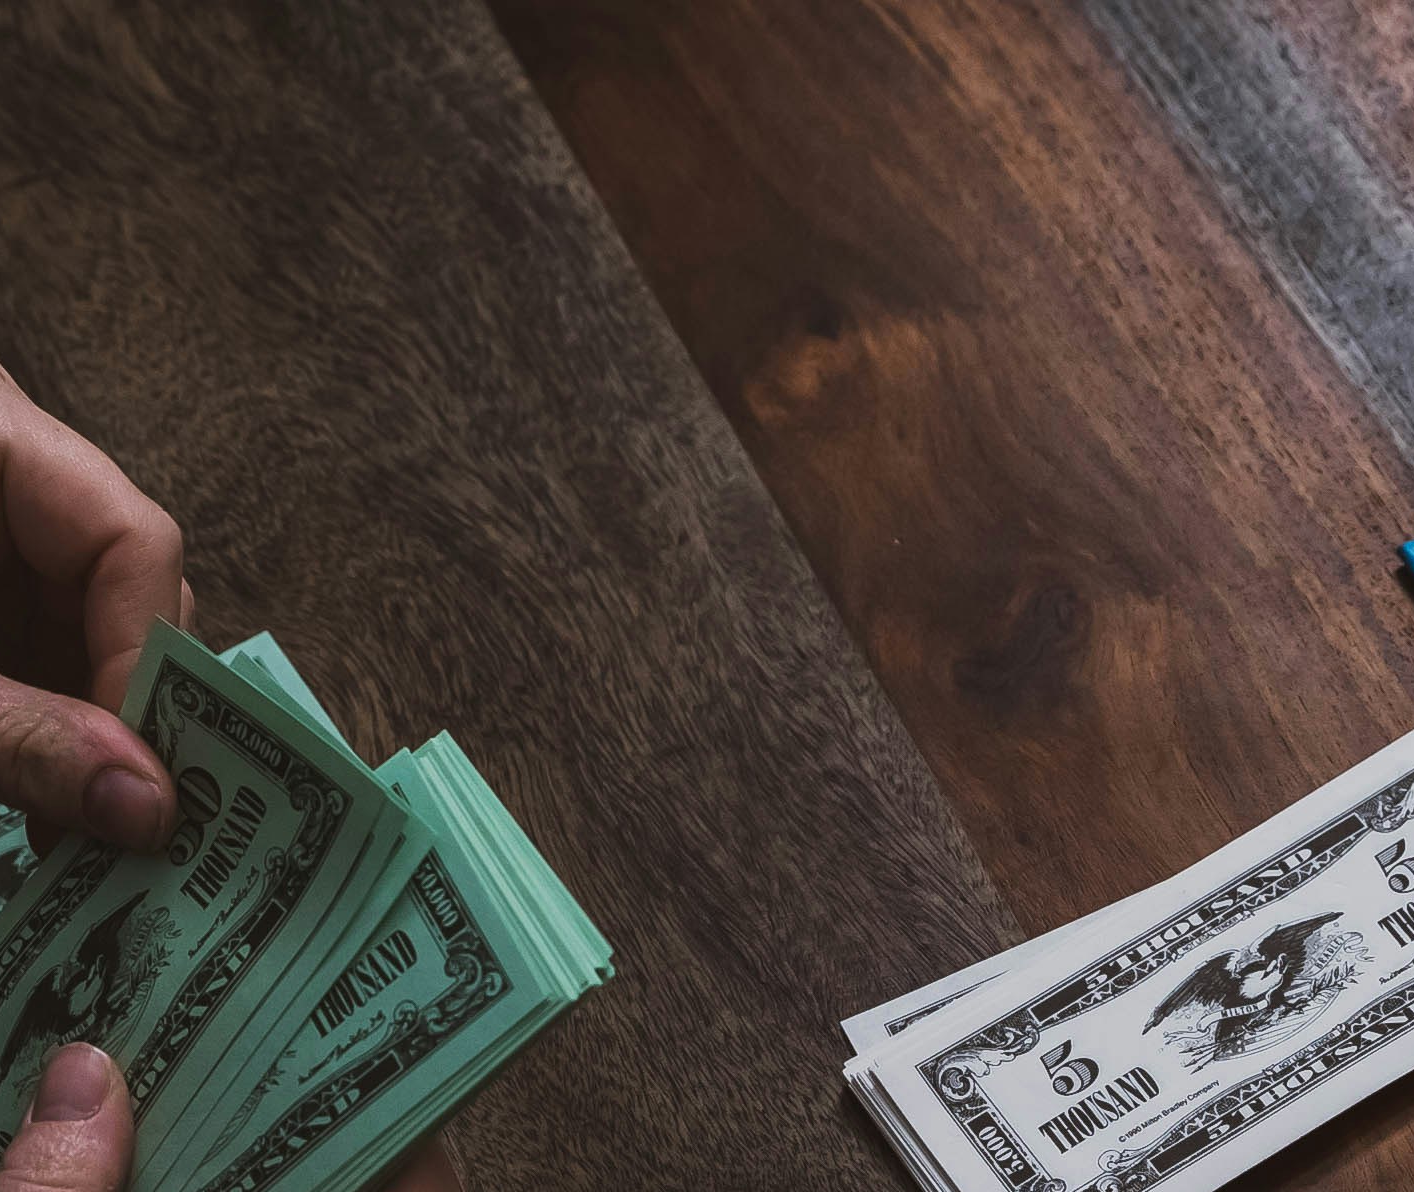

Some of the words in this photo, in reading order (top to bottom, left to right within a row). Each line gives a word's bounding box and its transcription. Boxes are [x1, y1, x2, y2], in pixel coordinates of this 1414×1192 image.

[180, 785, 267, 911] THOUSAND
[1085, 969, 1109, 990] 5
[1109, 847, 1313, 971] THOUSAND
[1314, 935, 1345, 969] BRADLEY
[310, 929, 417, 1039] THOUSAND
[1221, 1003, 1259, 1018] MILTON
[1039, 1039, 1099, 1096] 5
[1037, 1066, 1159, 1154] THOUSAND
[1141, 1114, 1163, 1131] Milton
[1162, 1098, 1188, 1117] Bradley
[1187, 1080, 1219, 1103] Company
[1208, 1122, 1231, 1140] 5
